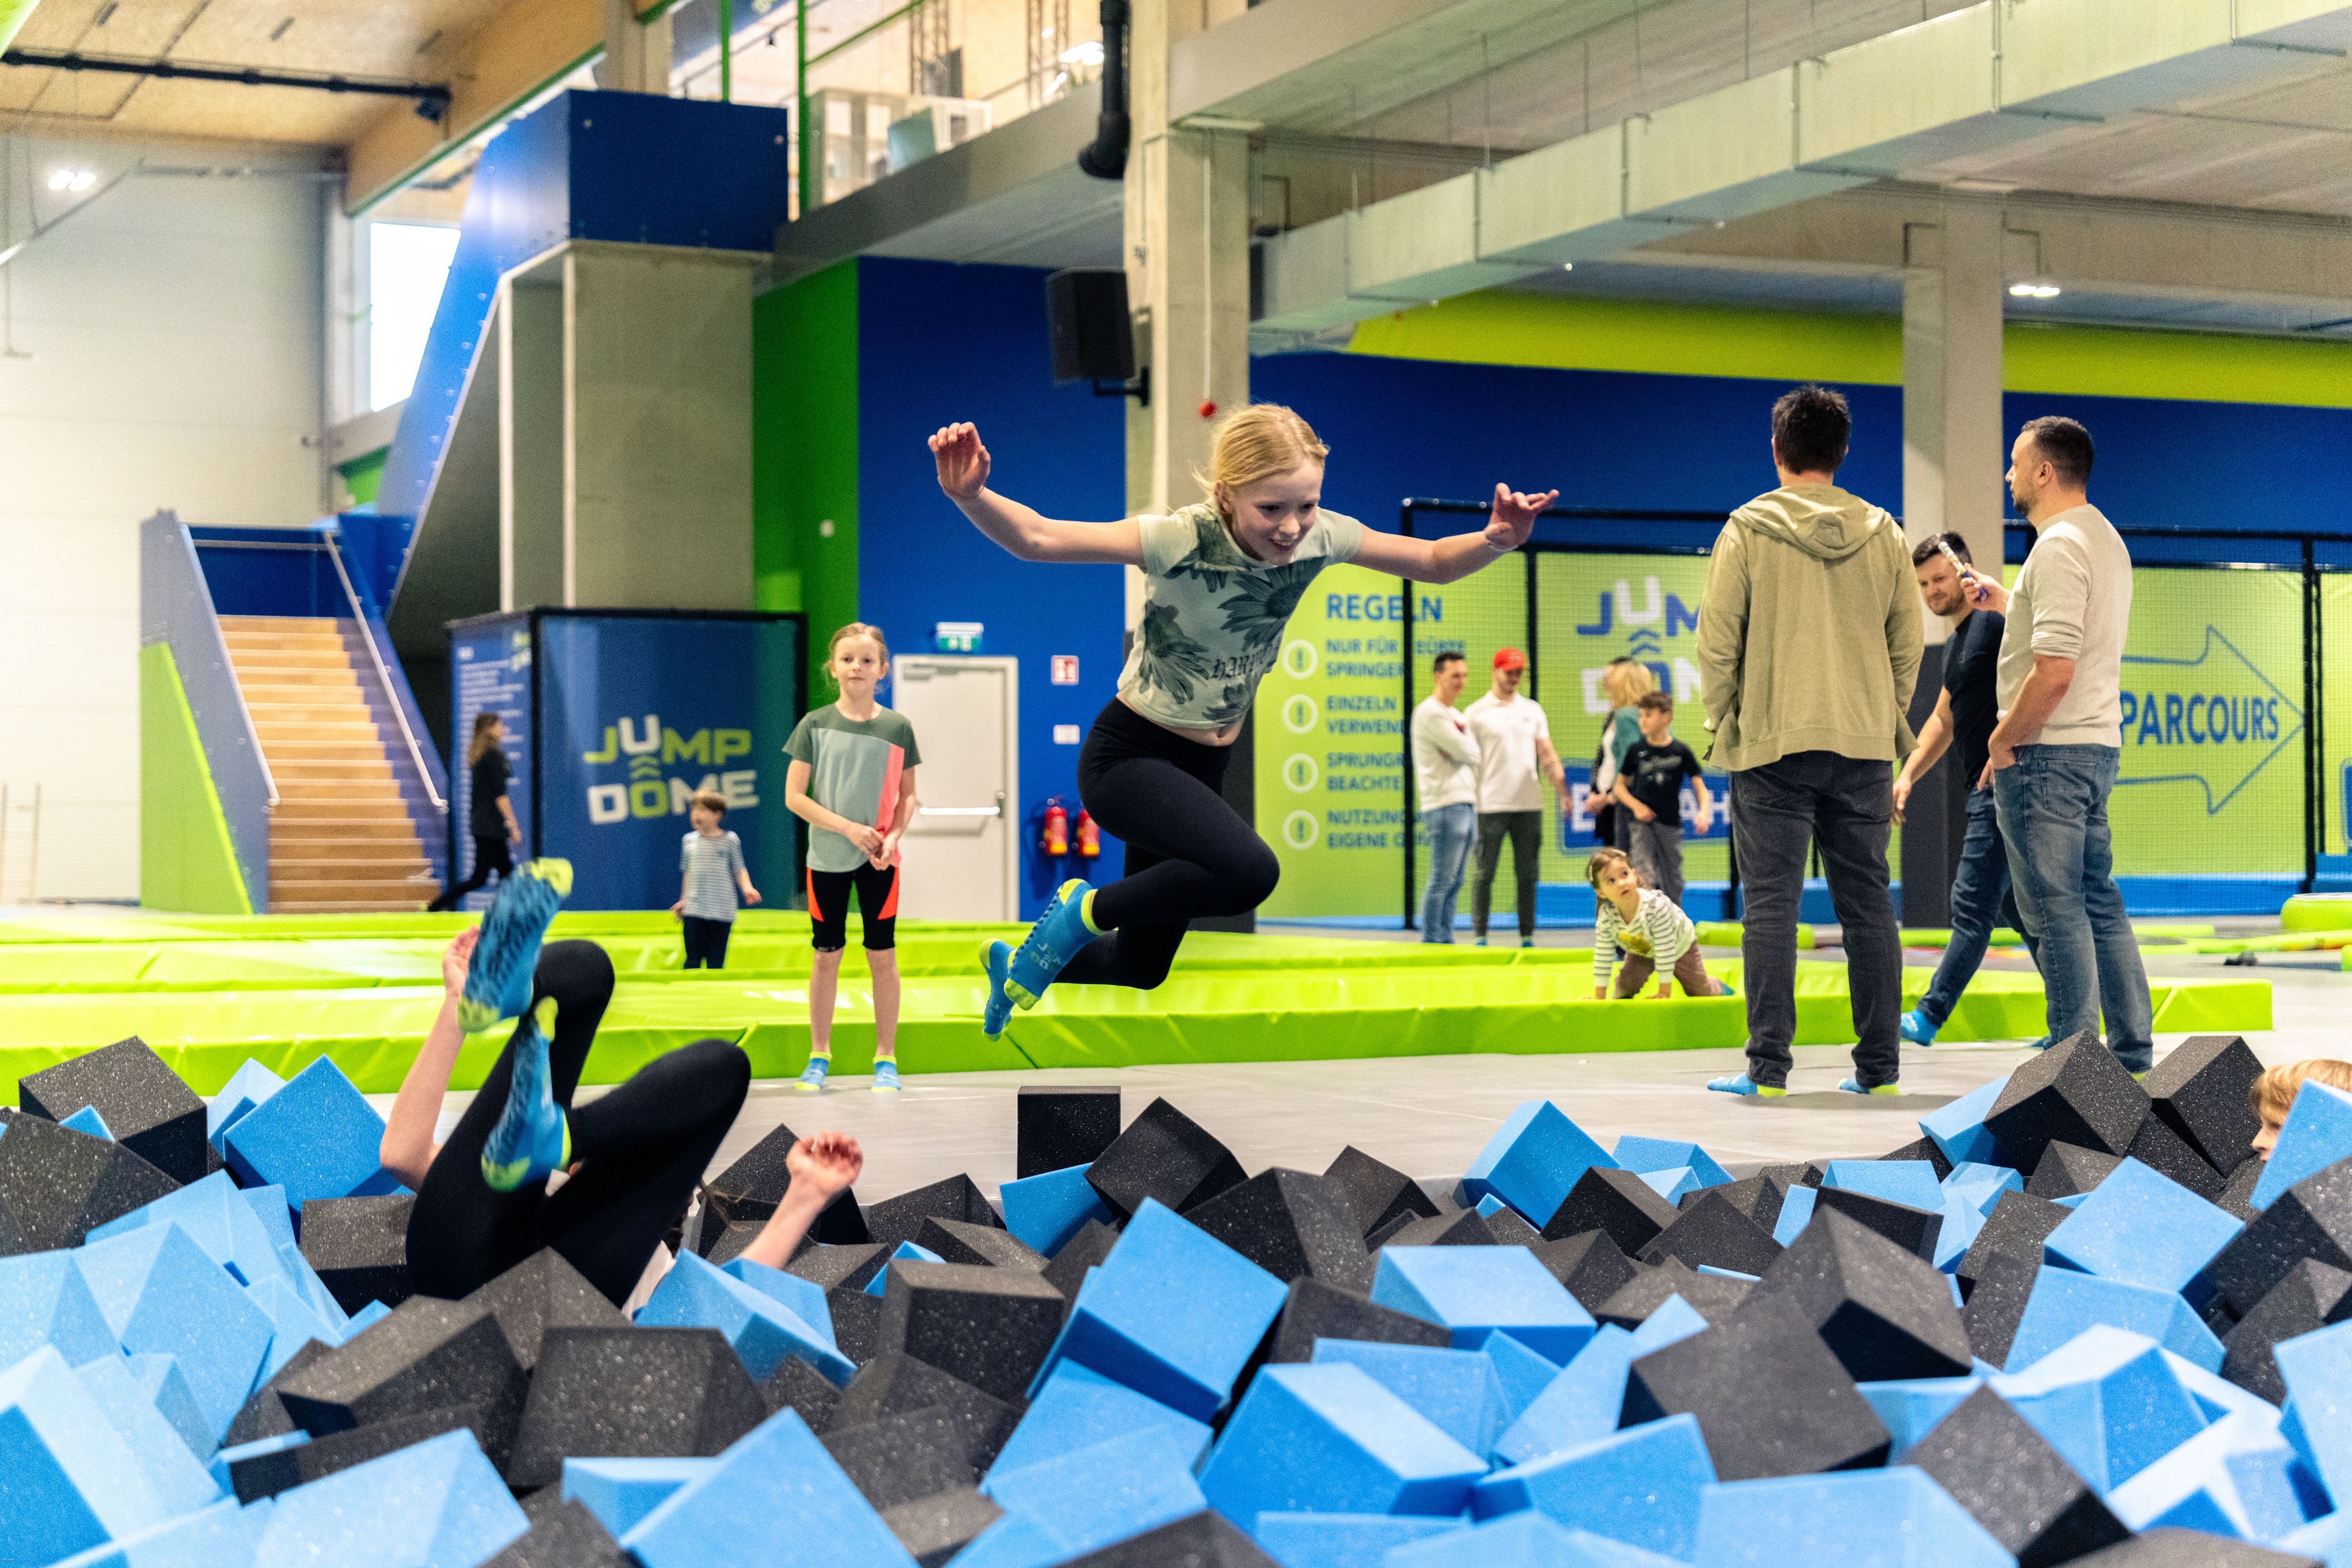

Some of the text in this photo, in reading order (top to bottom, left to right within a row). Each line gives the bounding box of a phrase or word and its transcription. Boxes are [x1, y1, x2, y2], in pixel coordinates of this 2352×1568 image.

[1326, 593, 1443, 622] REGEN
[1576, 575, 1703, 637] JUM
[1325, 638, 1361, 654] NUR
[1326, 695, 1397, 712] EINZELN
[1326, 719, 1405, 735] VERWEN
[2119, 691, 2278, 745] PARCOURS
[583, 713, 752, 765] JUMP
[1326, 775, 1404, 792] BEACHTE
[587, 769, 761, 825] DOME
[1326, 832, 1387, 849] EIGENE
